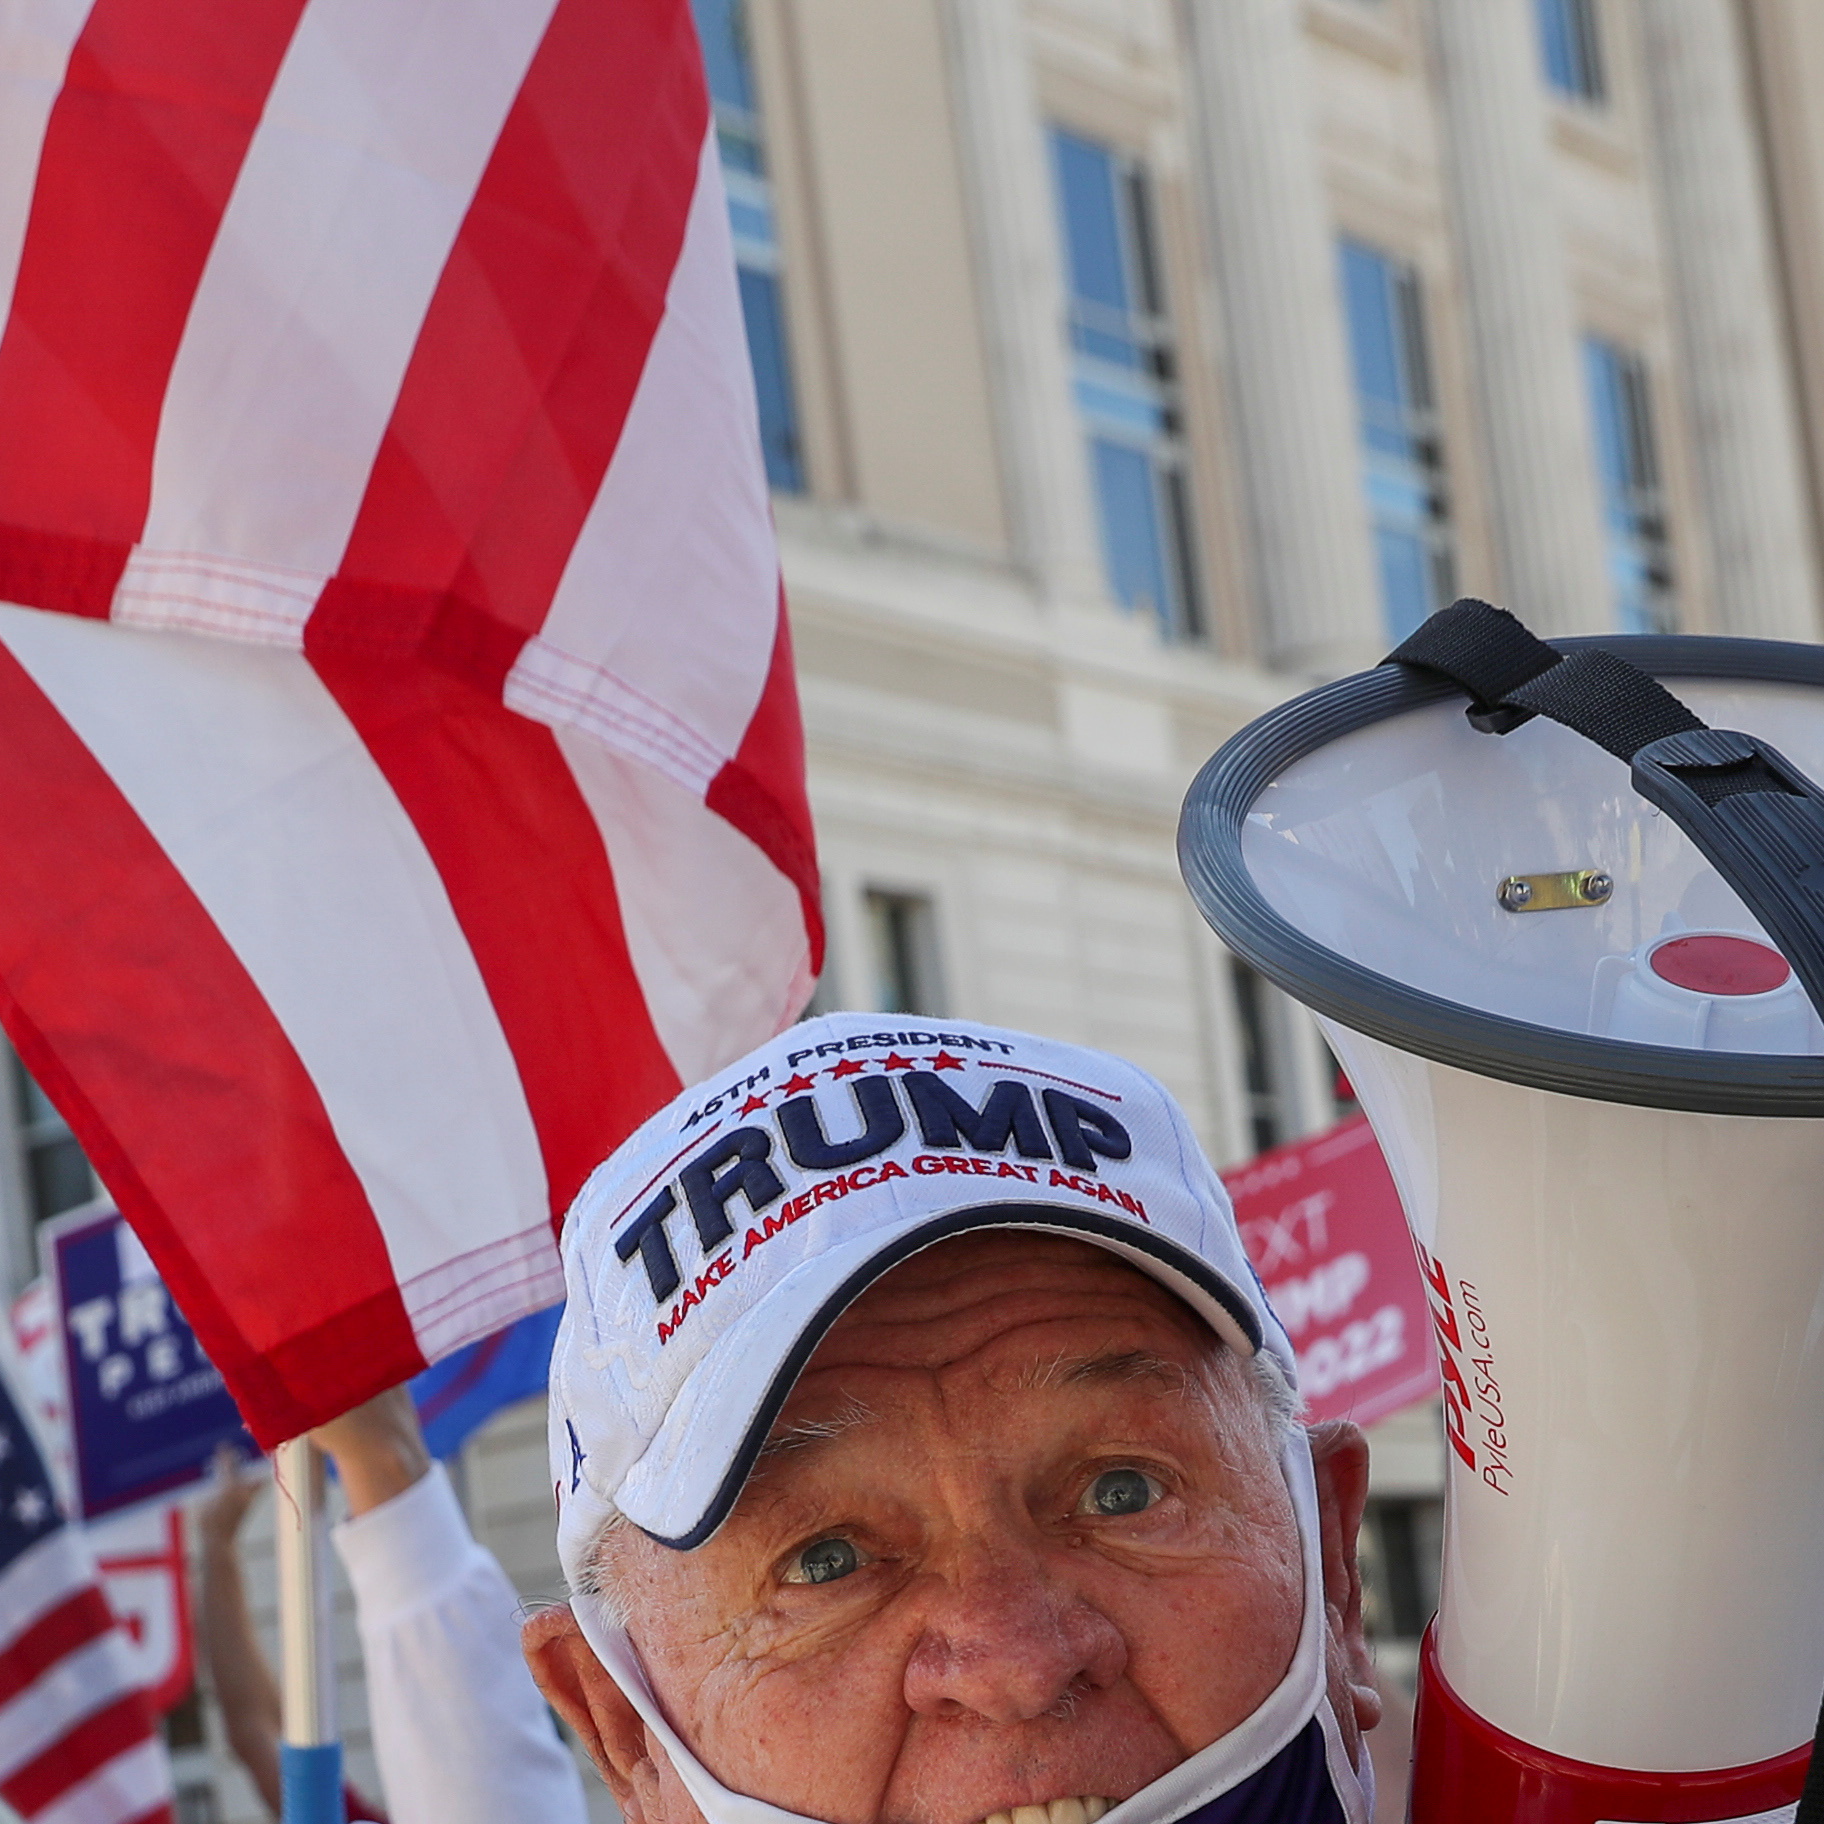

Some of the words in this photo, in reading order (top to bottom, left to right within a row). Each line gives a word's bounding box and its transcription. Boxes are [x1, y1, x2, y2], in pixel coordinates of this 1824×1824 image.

[679, 1065, 771, 1134] 45TH
[786, 1031, 1016, 1068] PRESIDENT
[613, 1070, 1133, 1305] TRUMP
[656, 1247, 738, 1346] MAKE
[742, 1160, 911, 1261] AMERICA
[911, 1154, 1040, 1184] GREAT
[1048, 1168, 1152, 1226] AGAIN
[1457, 1279, 1514, 1497] PyleUSA.com
